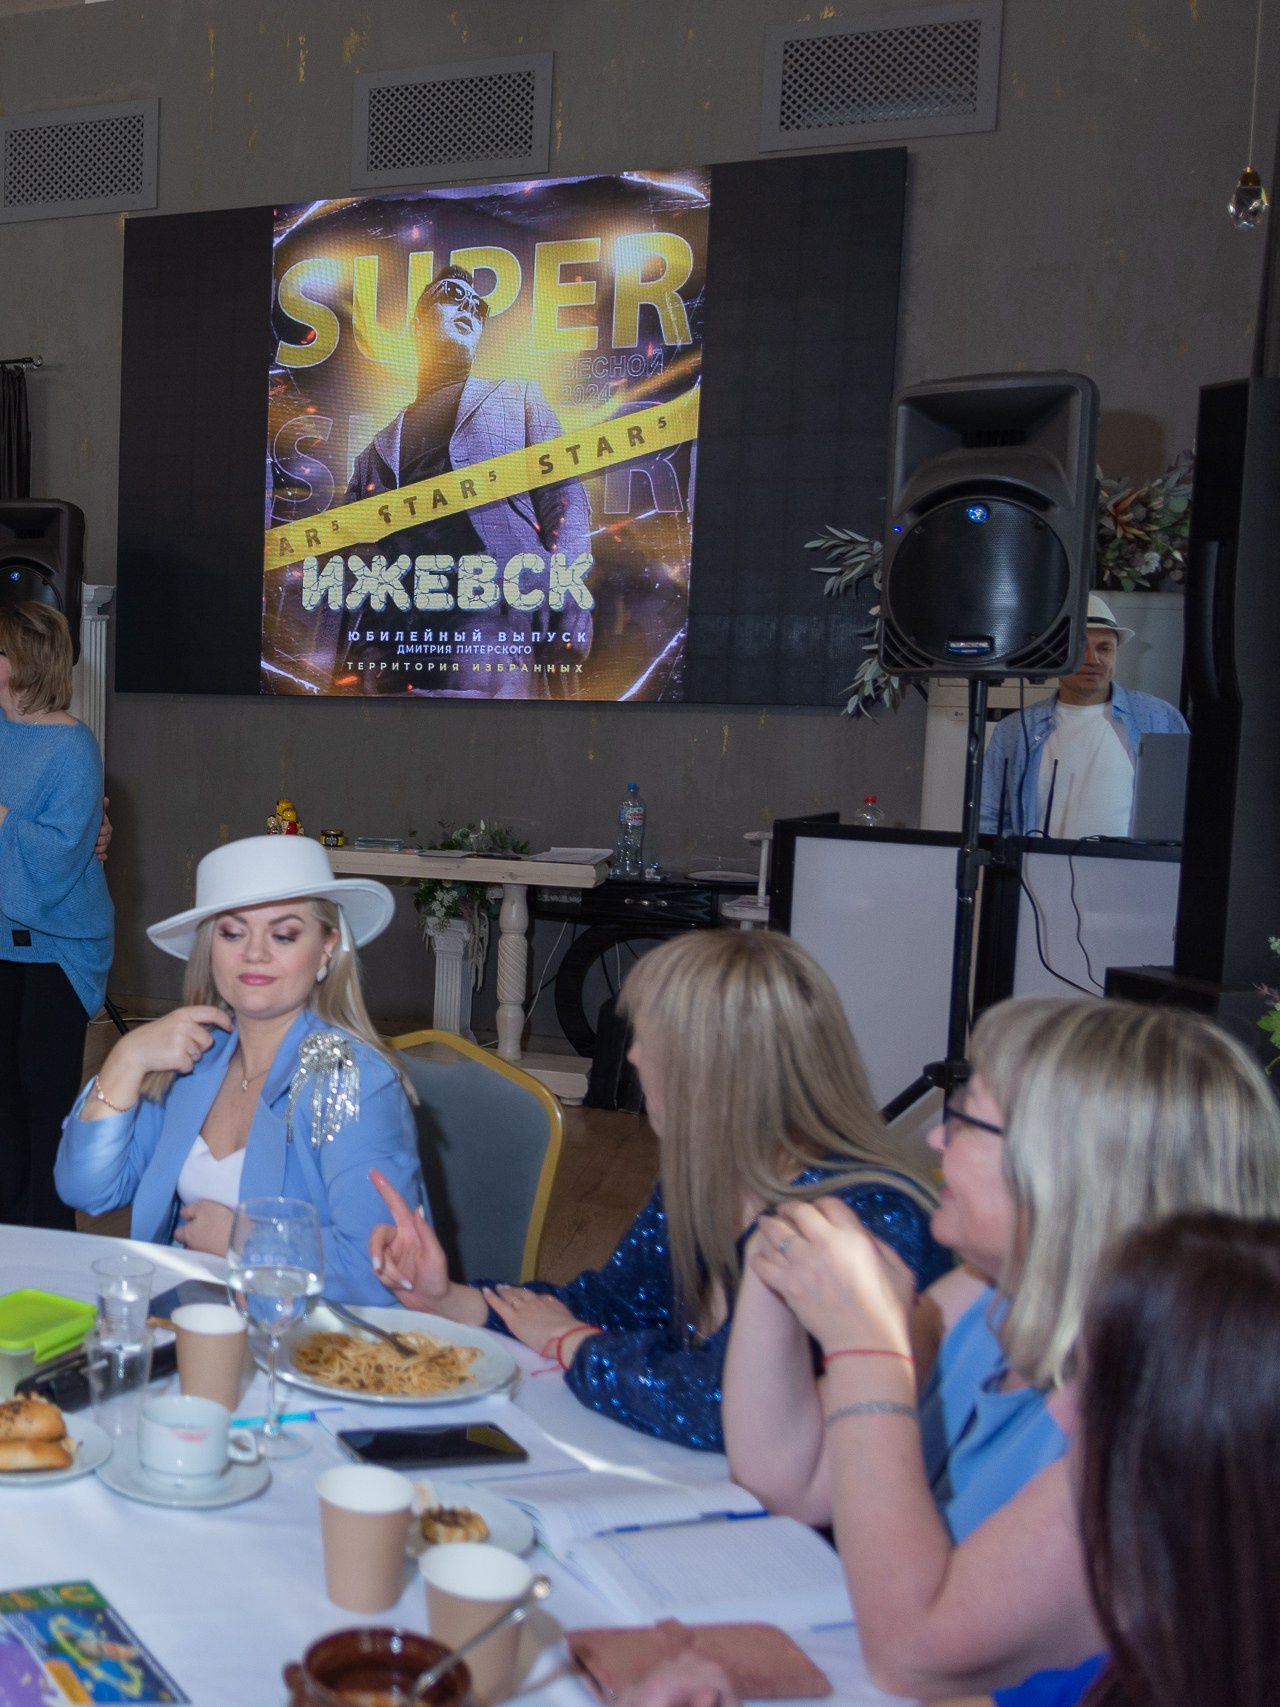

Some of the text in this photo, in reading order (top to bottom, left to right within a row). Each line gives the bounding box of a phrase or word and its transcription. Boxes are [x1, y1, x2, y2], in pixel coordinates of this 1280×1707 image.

[274, 231, 694, 370] SUPER
[560, 347, 665, 381] ВЕСНОЙ
[560, 382, 613, 406] 2024
[301, 551, 597, 613] ИЖЕВСК
[347, 628, 587, 643] ЮБИЛЕЙНЫЙ ВЫПУСК
[396, 644, 533, 656] ДМИТРИЯ ПИТЕРСКОГО
[346, 661, 584, 674] ТЕРРИТОРИЯ ИЗБРАННЫХ
